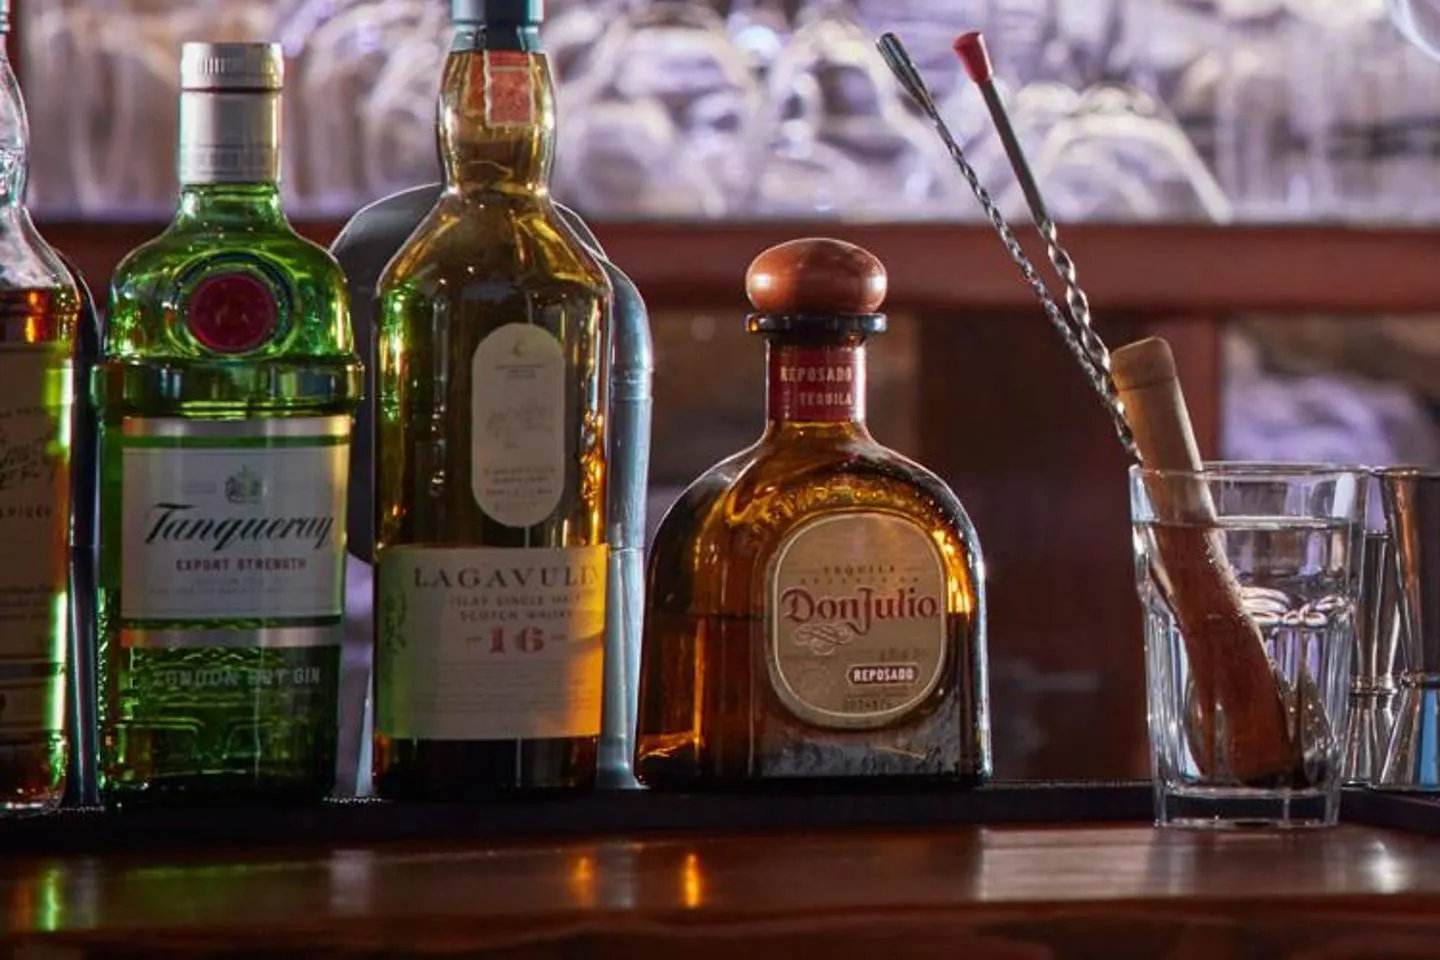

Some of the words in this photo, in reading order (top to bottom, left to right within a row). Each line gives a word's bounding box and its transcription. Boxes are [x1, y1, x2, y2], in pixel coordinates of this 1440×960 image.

[780, 366, 853, 383] REPOSADO
[799, 392, 853, 407] TEQUILA
[144, 502, 334, 552] Tanqueray
[175, 557, 230, 572] EXPORT
[237, 556, 307, 571] STRENGTH
[293, 667, 321, 684] GIN
[853, 667, 914, 682] REPOSADO
